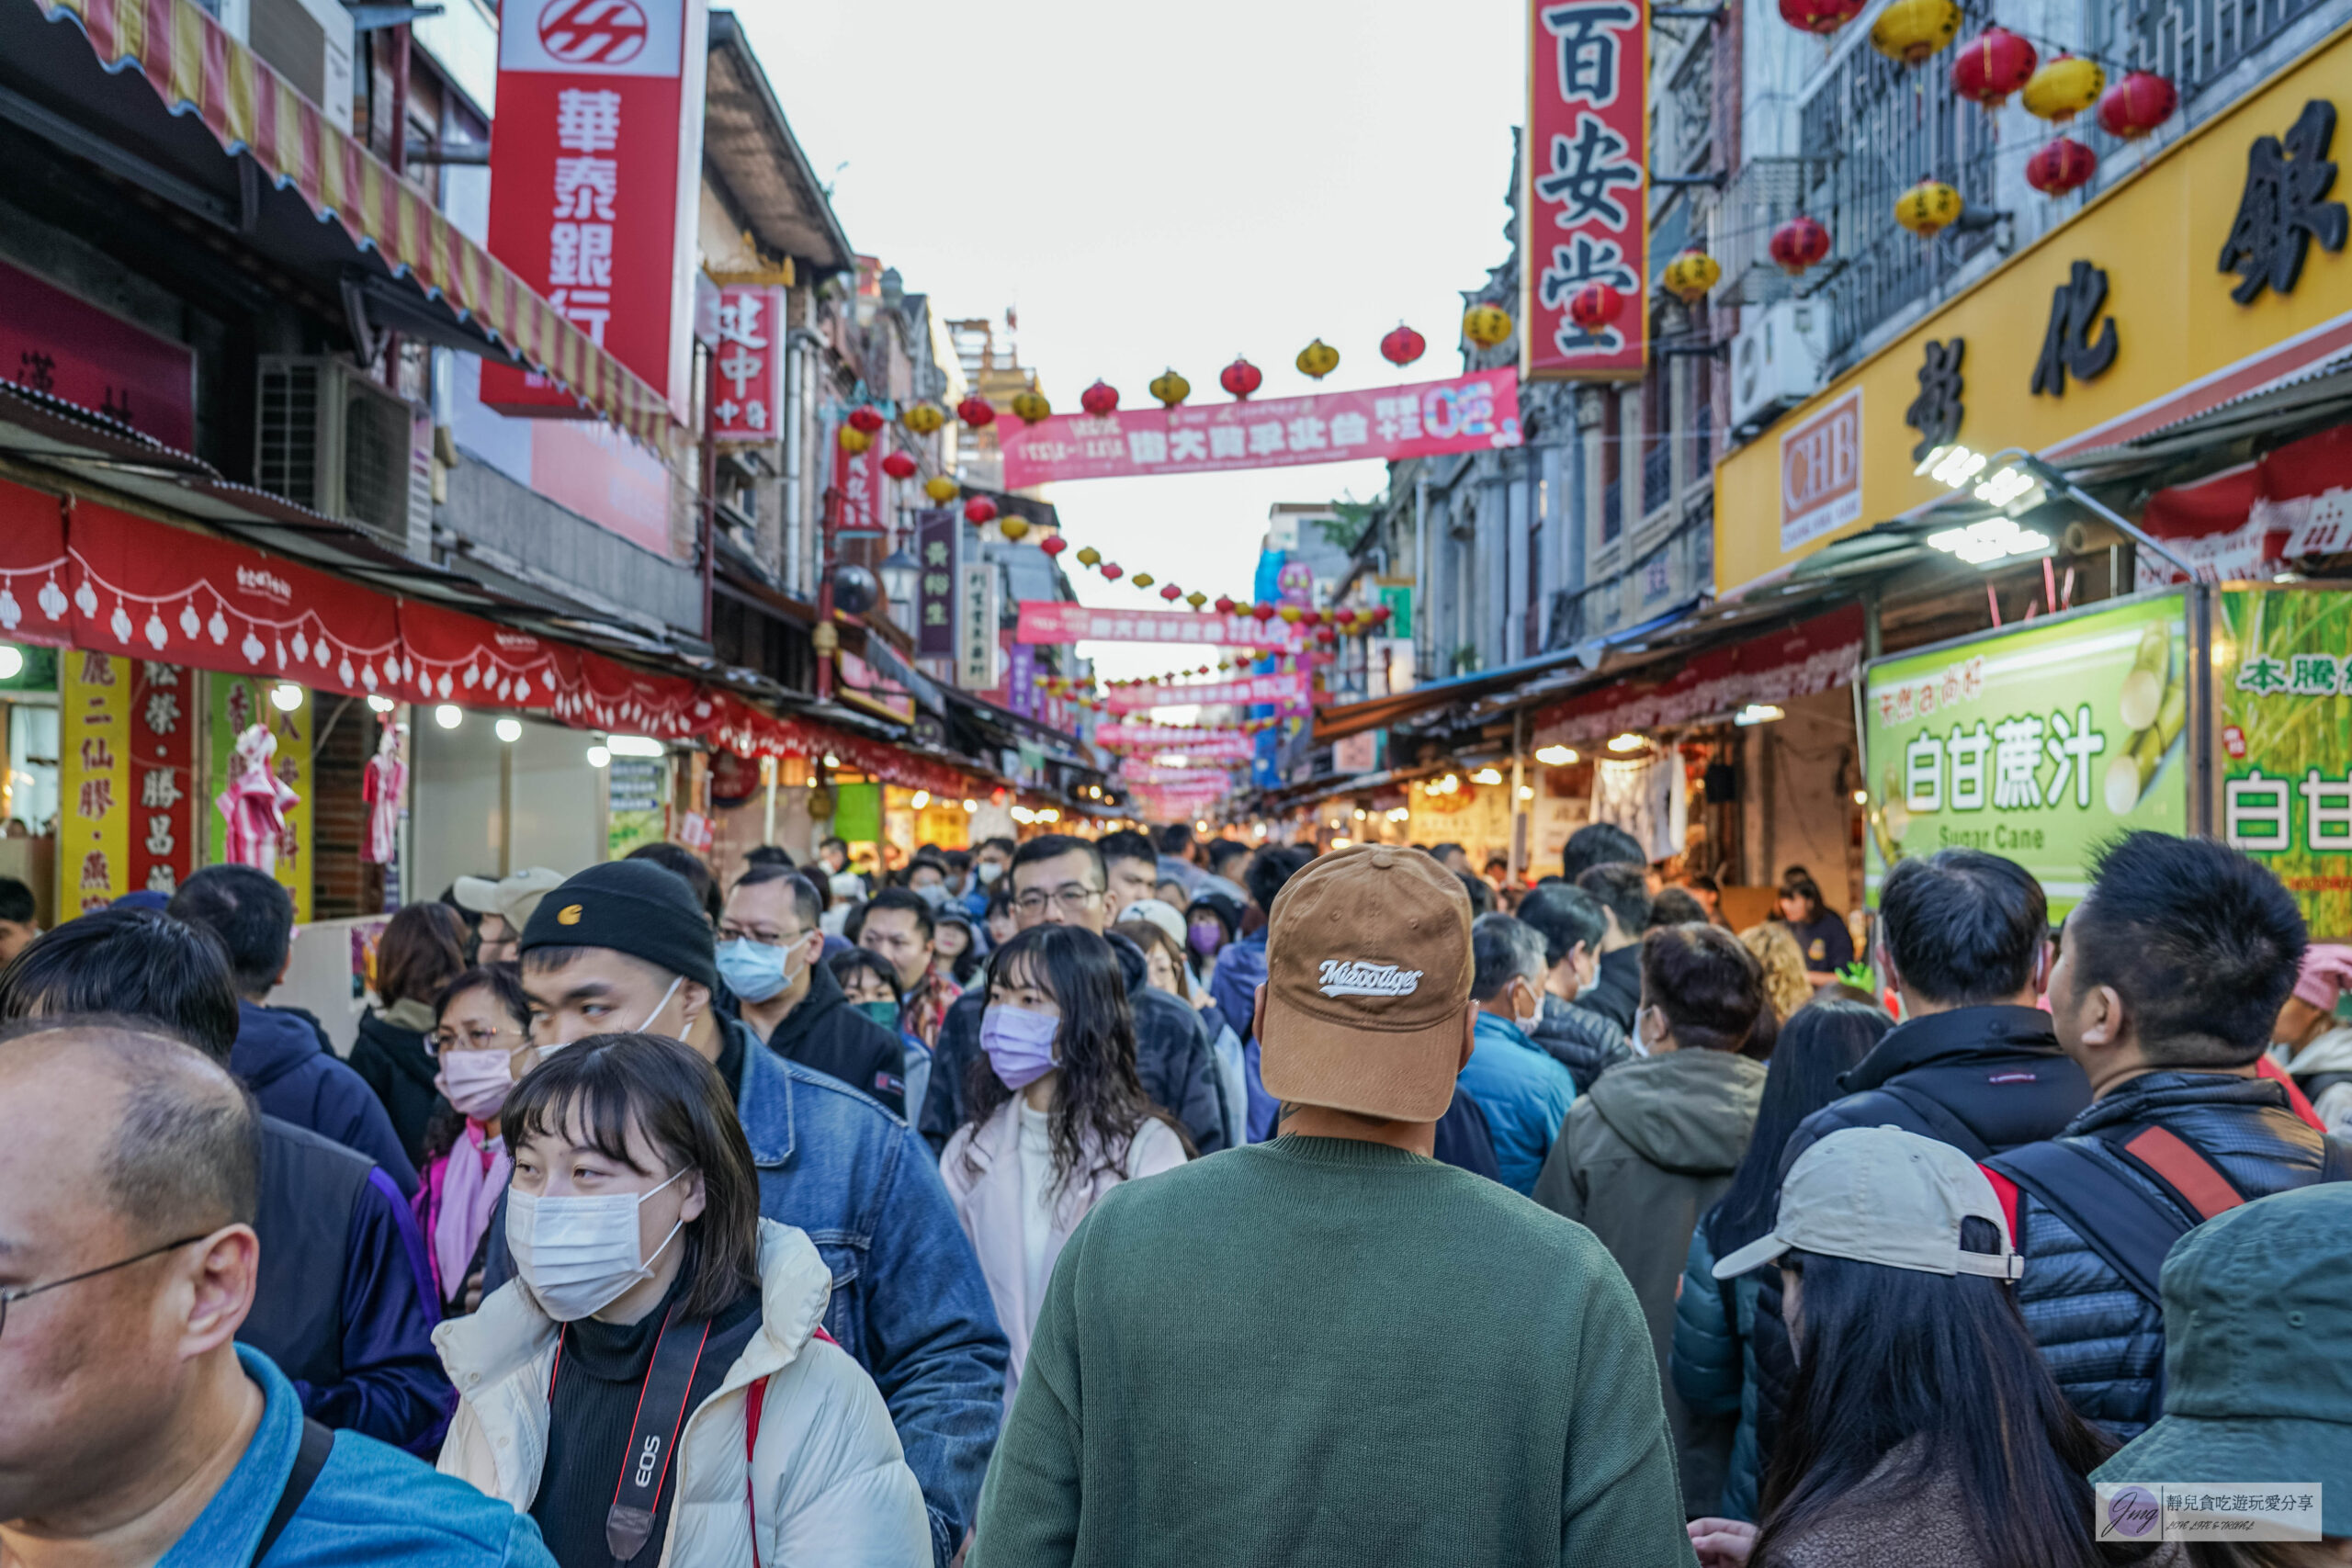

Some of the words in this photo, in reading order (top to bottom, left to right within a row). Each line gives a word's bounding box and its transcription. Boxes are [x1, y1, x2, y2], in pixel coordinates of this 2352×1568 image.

[548, 89, 621, 348] 華泰銀行
[1783, 411, 1857, 512] CHB
[1906, 705, 2105, 812] 白甘蔗汁
[1939, 826, 1989, 850] Sugar
[1994, 825, 2045, 850] Cane
[635, 1435, 661, 1488] EOS
